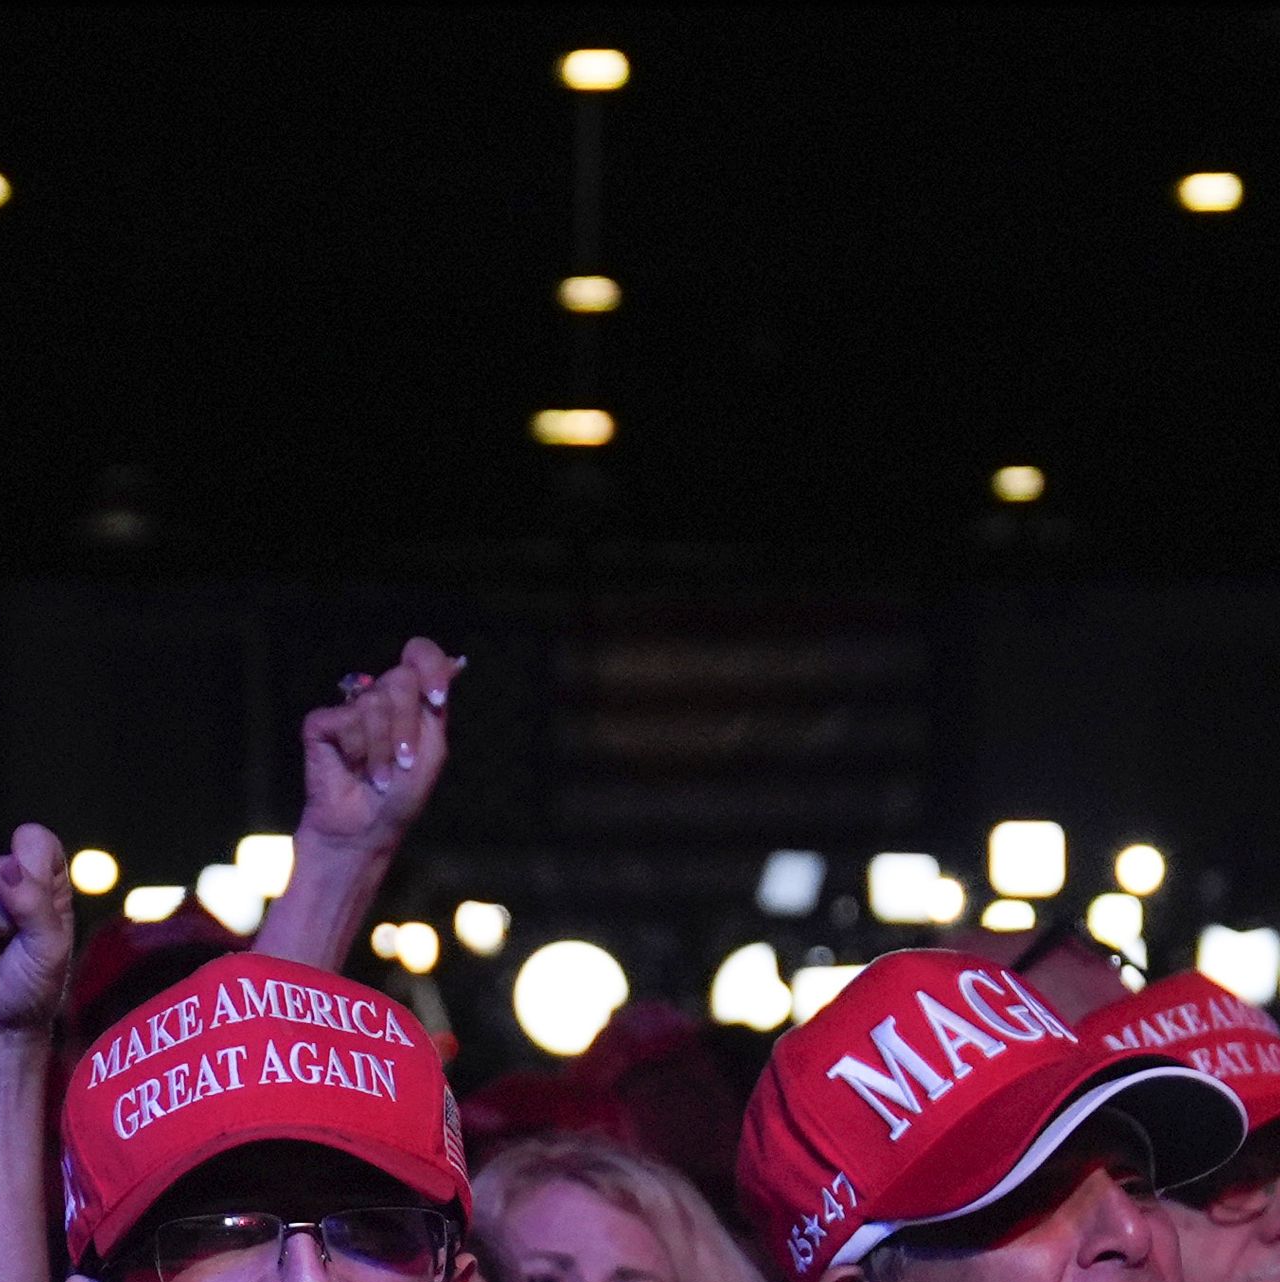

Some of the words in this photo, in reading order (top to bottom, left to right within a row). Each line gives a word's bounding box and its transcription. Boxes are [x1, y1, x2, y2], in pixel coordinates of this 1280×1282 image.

[87, 994, 204, 1089] MAKE
[209, 977, 415, 1048] AMERICA
[826, 968, 1079, 1142] MAGA
[1103, 1002, 1210, 1051] MAKE
[112, 1045, 248, 1141] GREAT
[258, 1039, 398, 1102] AGAIN
[821, 1170, 858, 1225] 47
